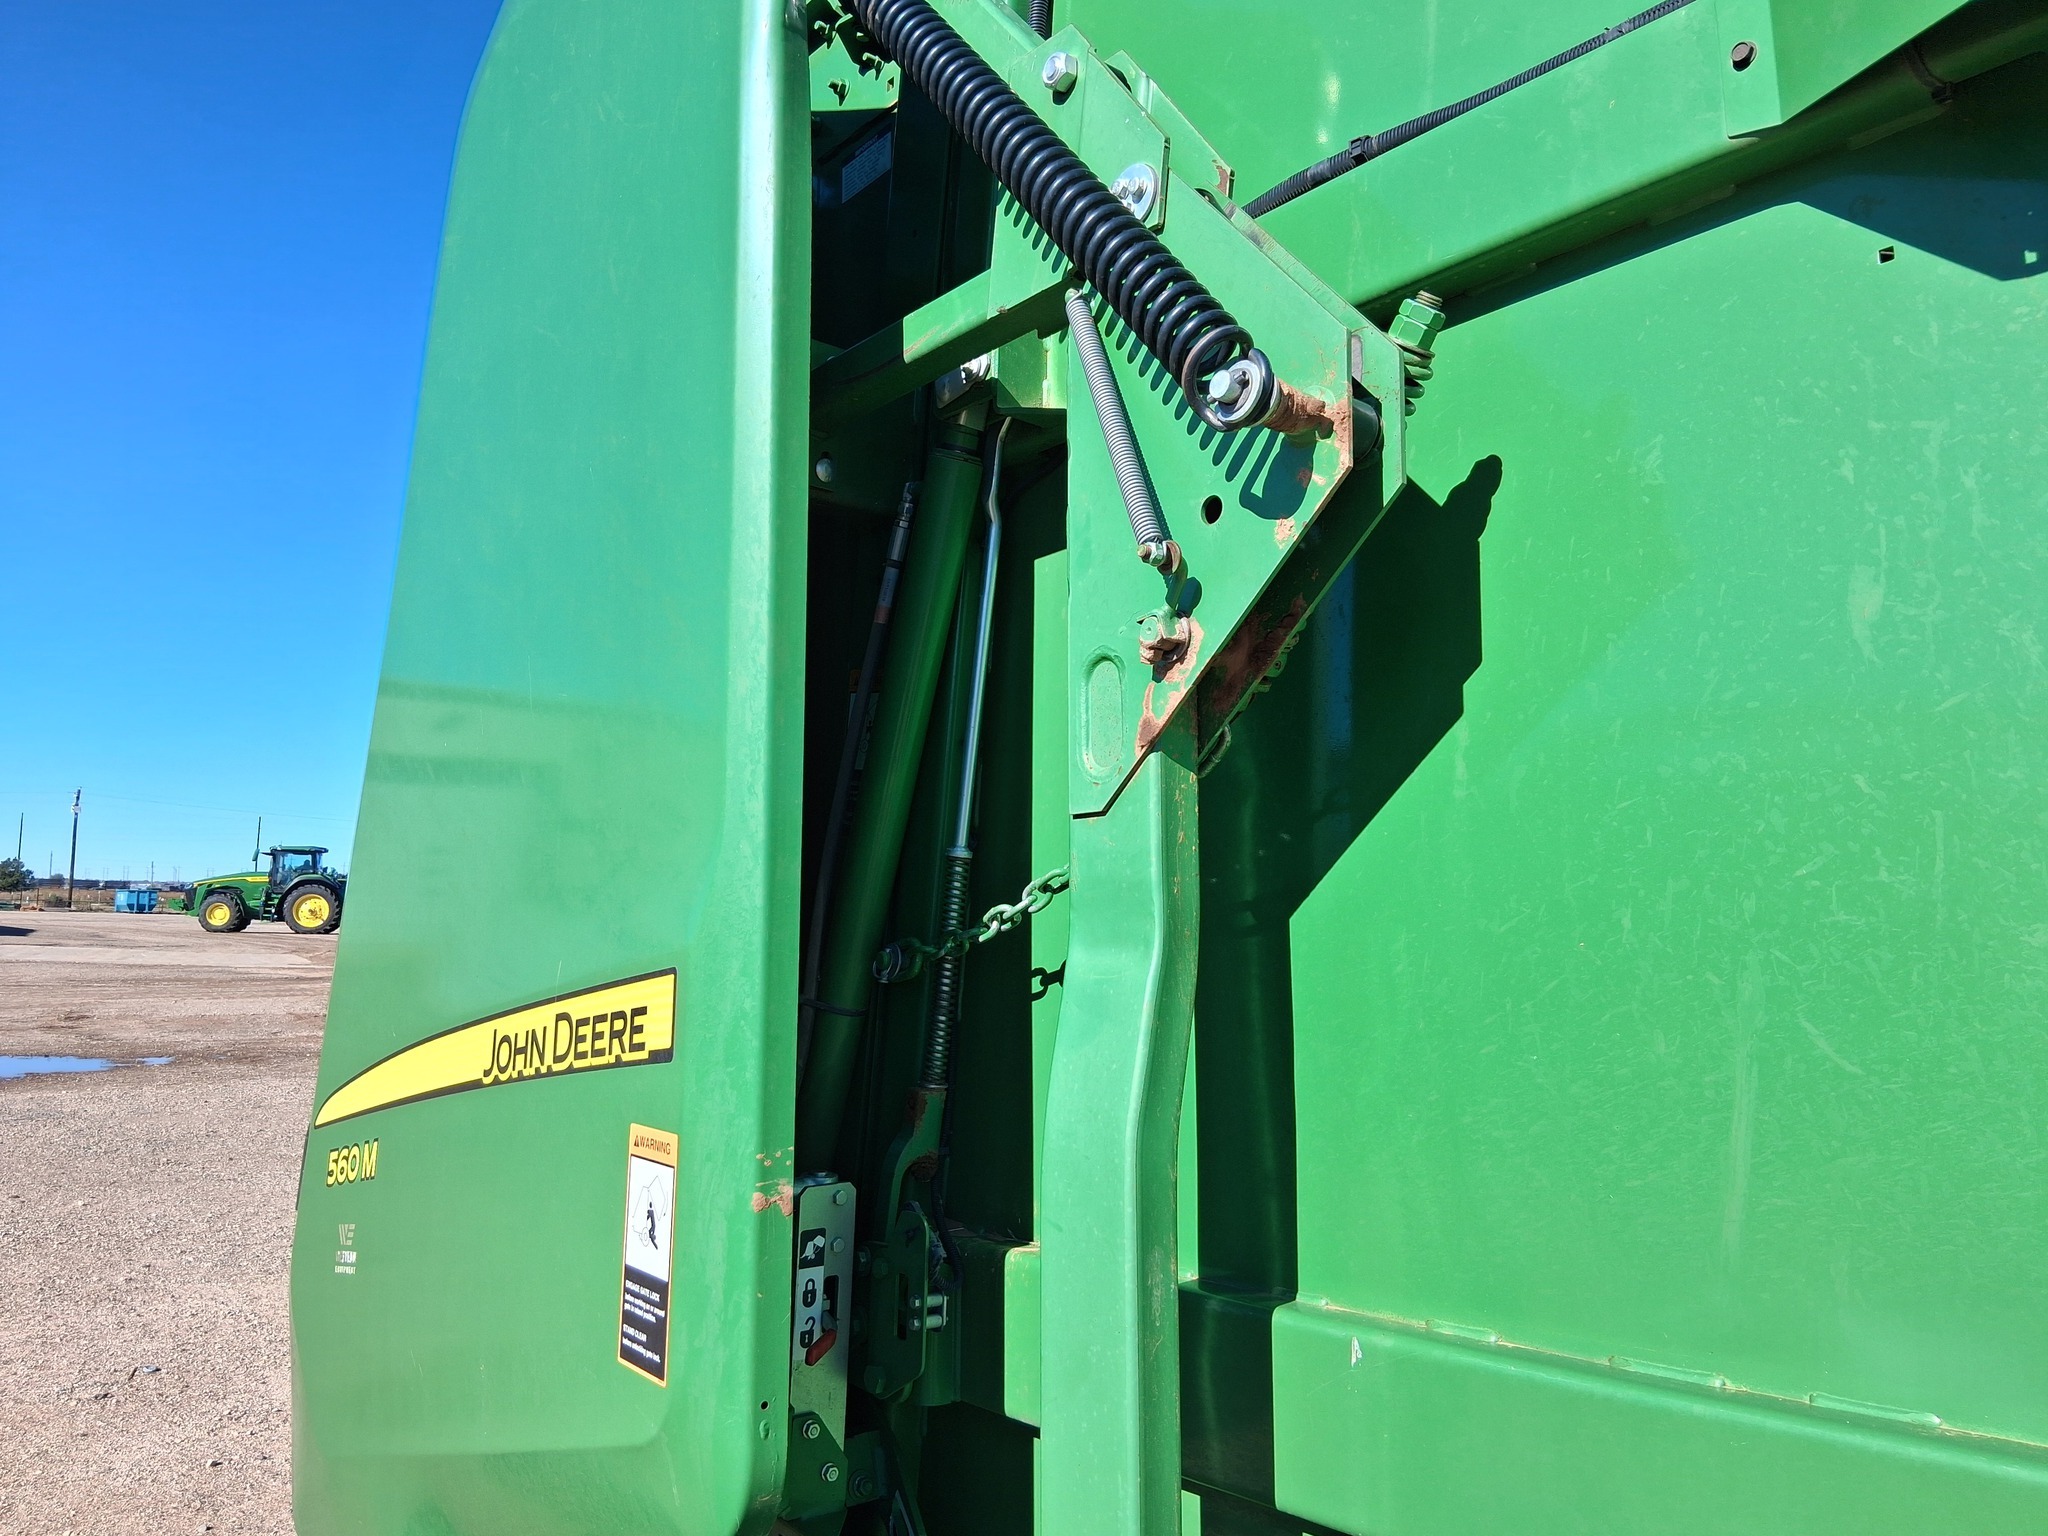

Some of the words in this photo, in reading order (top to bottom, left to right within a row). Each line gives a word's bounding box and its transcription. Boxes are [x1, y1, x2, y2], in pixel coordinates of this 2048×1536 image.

[483, 1026, 547, 1078] JOHN
[553, 1006, 647, 1064] DEERE
[640, 1135, 671, 1155] WARNING
[650, 1290, 660, 1303] LOCK
[635, 1329, 647, 1342] CLEAR
